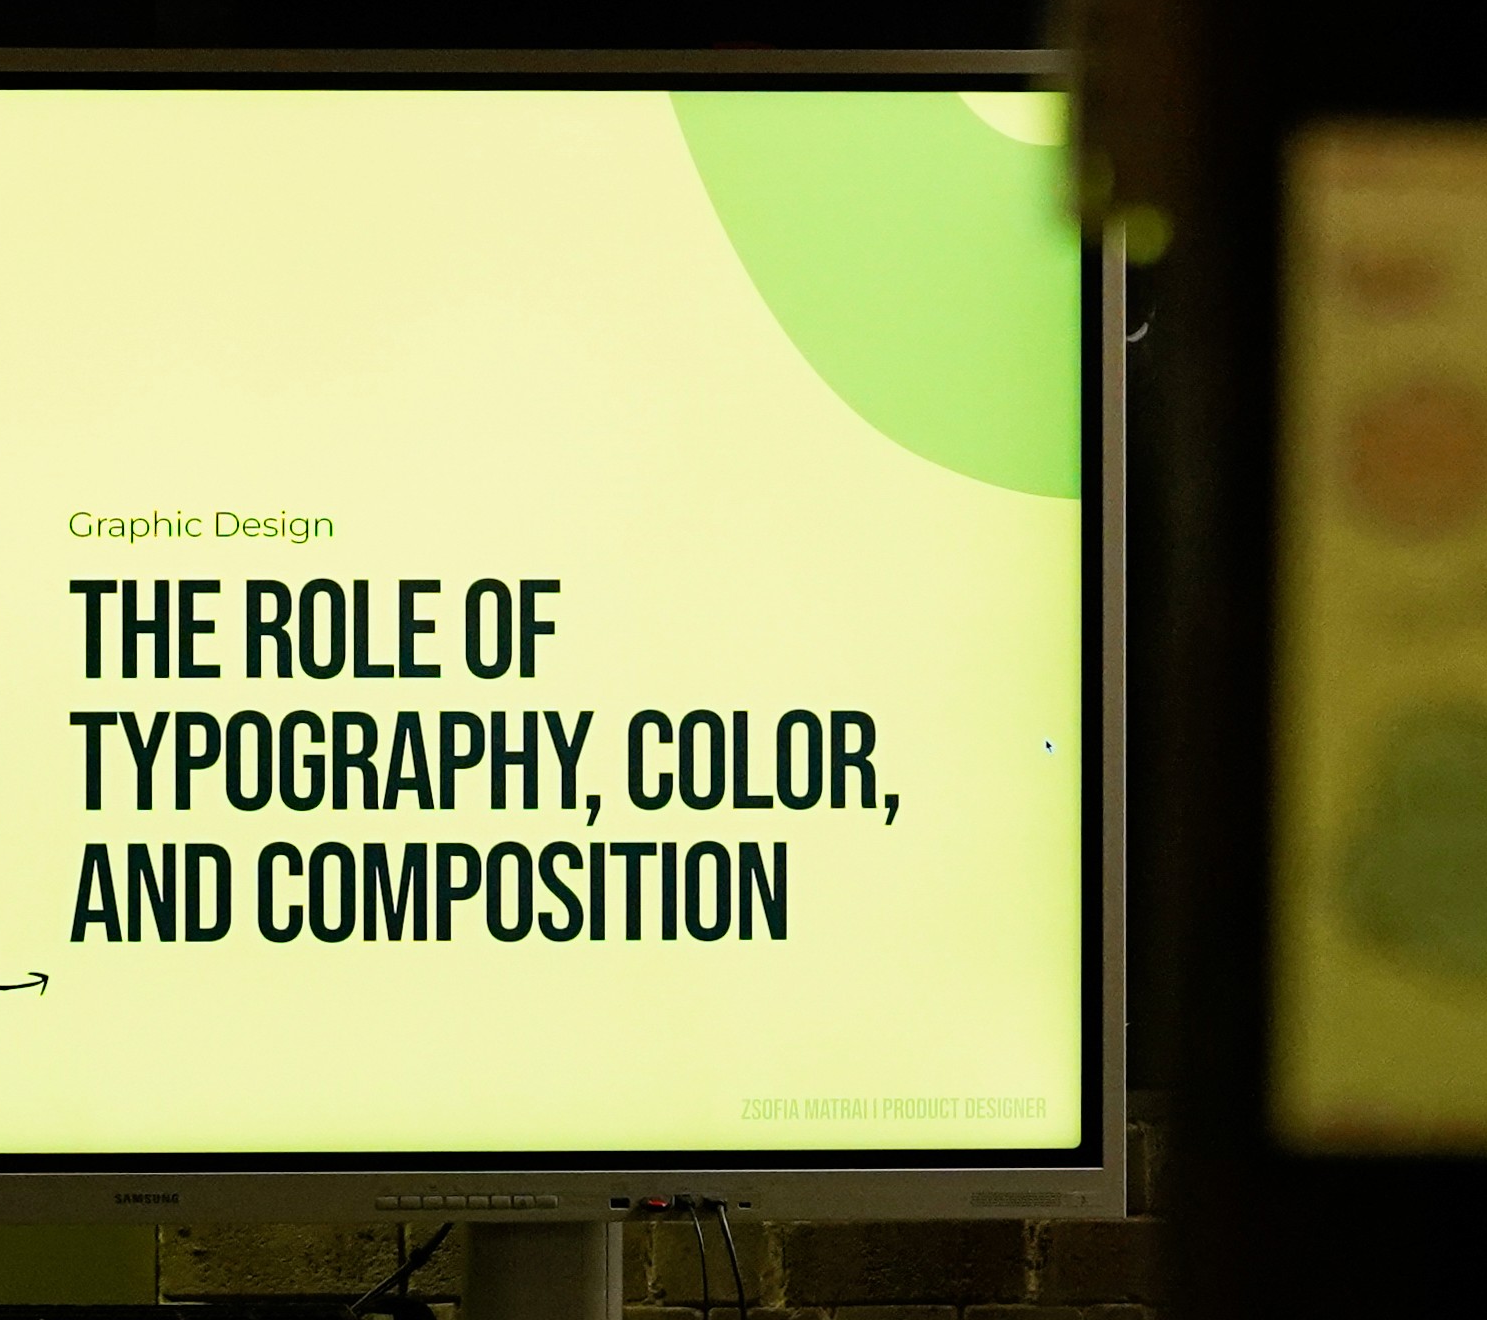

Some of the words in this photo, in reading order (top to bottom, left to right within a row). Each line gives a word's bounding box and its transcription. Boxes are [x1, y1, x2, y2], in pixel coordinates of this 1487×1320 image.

[70, 511, 202, 544] Graphic
[215, 511, 334, 545] Design
[69, 580, 221, 679] THE
[246, 578, 442, 680] ROLE
[464, 578, 561, 680] OF
[69, 709, 601, 827] TYPOGRAPHY,
[628, 708, 900, 826] COLOR,
[69, 842, 232, 943] AND
[257, 840, 788, 944] COMPOSITION
[741, 1098, 800, 1120] ZSOFIA
[804, 1098, 868, 1120] MATRAI
[882, 1097, 959, 1120] PRODUCT
[965, 1097, 1047, 1119] DESIGNER
[114, 1193, 179, 1204] SAMSUNG
